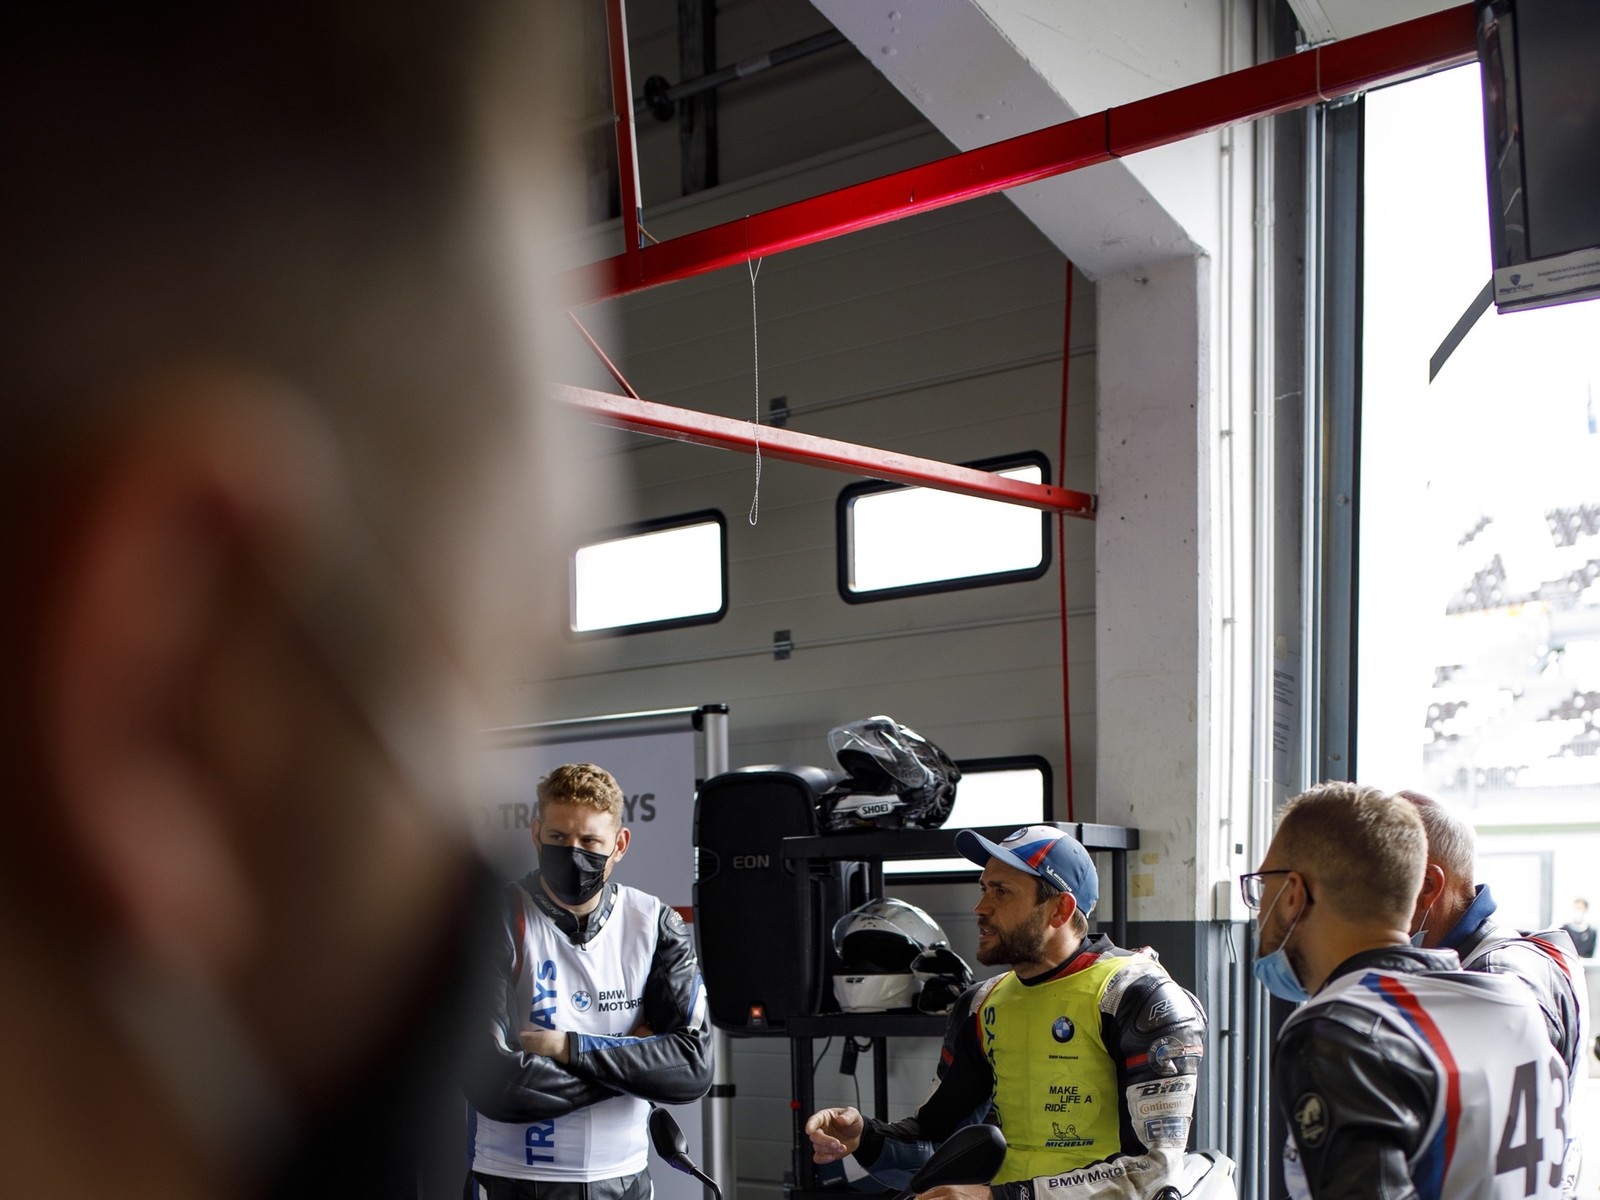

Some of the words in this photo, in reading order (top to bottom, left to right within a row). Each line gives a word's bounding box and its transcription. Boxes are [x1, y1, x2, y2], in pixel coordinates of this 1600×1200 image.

[862, 803, 889, 816] SHOEI
[733, 855, 770, 869] EON
[598, 990, 626, 1001] BMW
[1049, 1086, 1079, 1095] MAKE
[1060, 1095, 1081, 1104] LIFE
[1084, 1095, 1093, 1104] A
[1044, 1103, 1070, 1113] RIDE.
[1495, 1060, 1566, 1198] 43
[1045, 1140, 1094, 1148] MICHELIN
[1049, 1174, 1086, 1188] BMW
